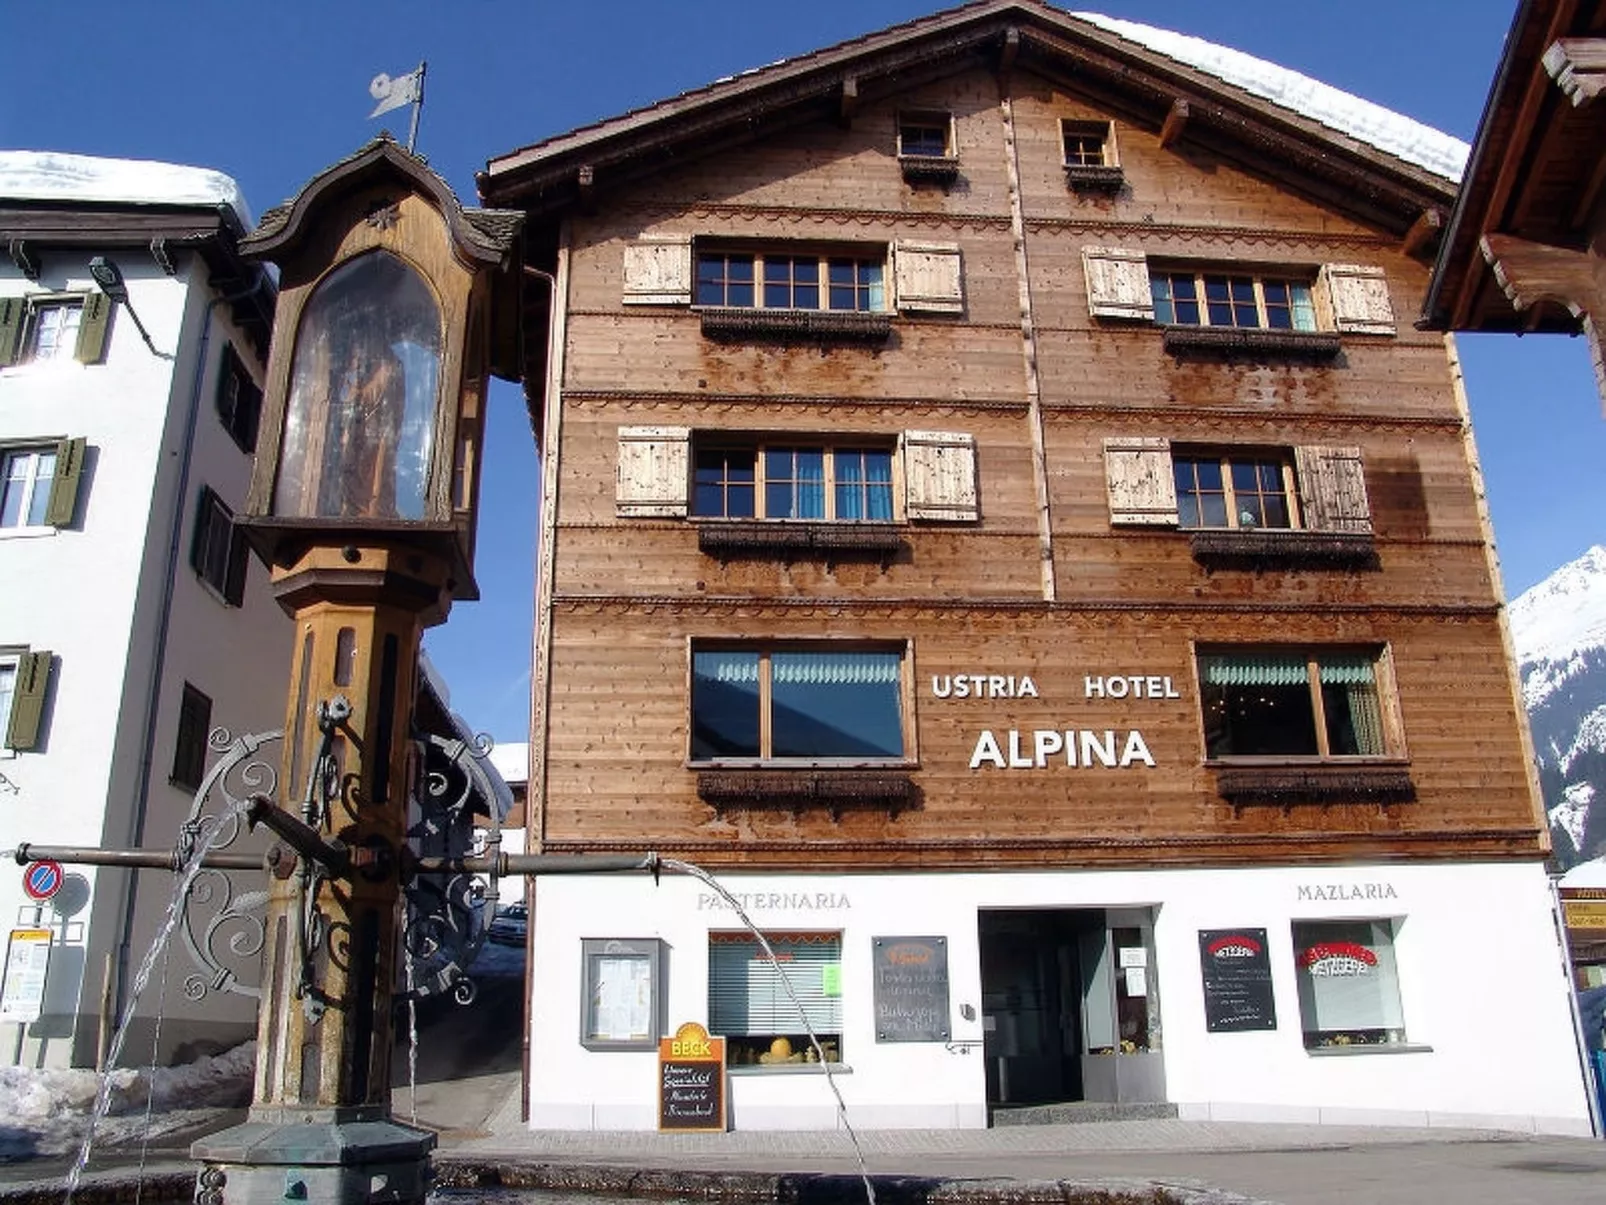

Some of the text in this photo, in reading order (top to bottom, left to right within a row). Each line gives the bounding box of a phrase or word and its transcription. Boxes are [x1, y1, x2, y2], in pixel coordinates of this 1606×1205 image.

[932, 675, 1180, 698] USTRIA HOTEL
[969, 730, 1156, 768] ALPINA
[1297, 883, 1398, 900] MAZLARIA
[697, 892, 852, 909] PASTERNARIA
[671, 1041, 712, 1056] BECK
